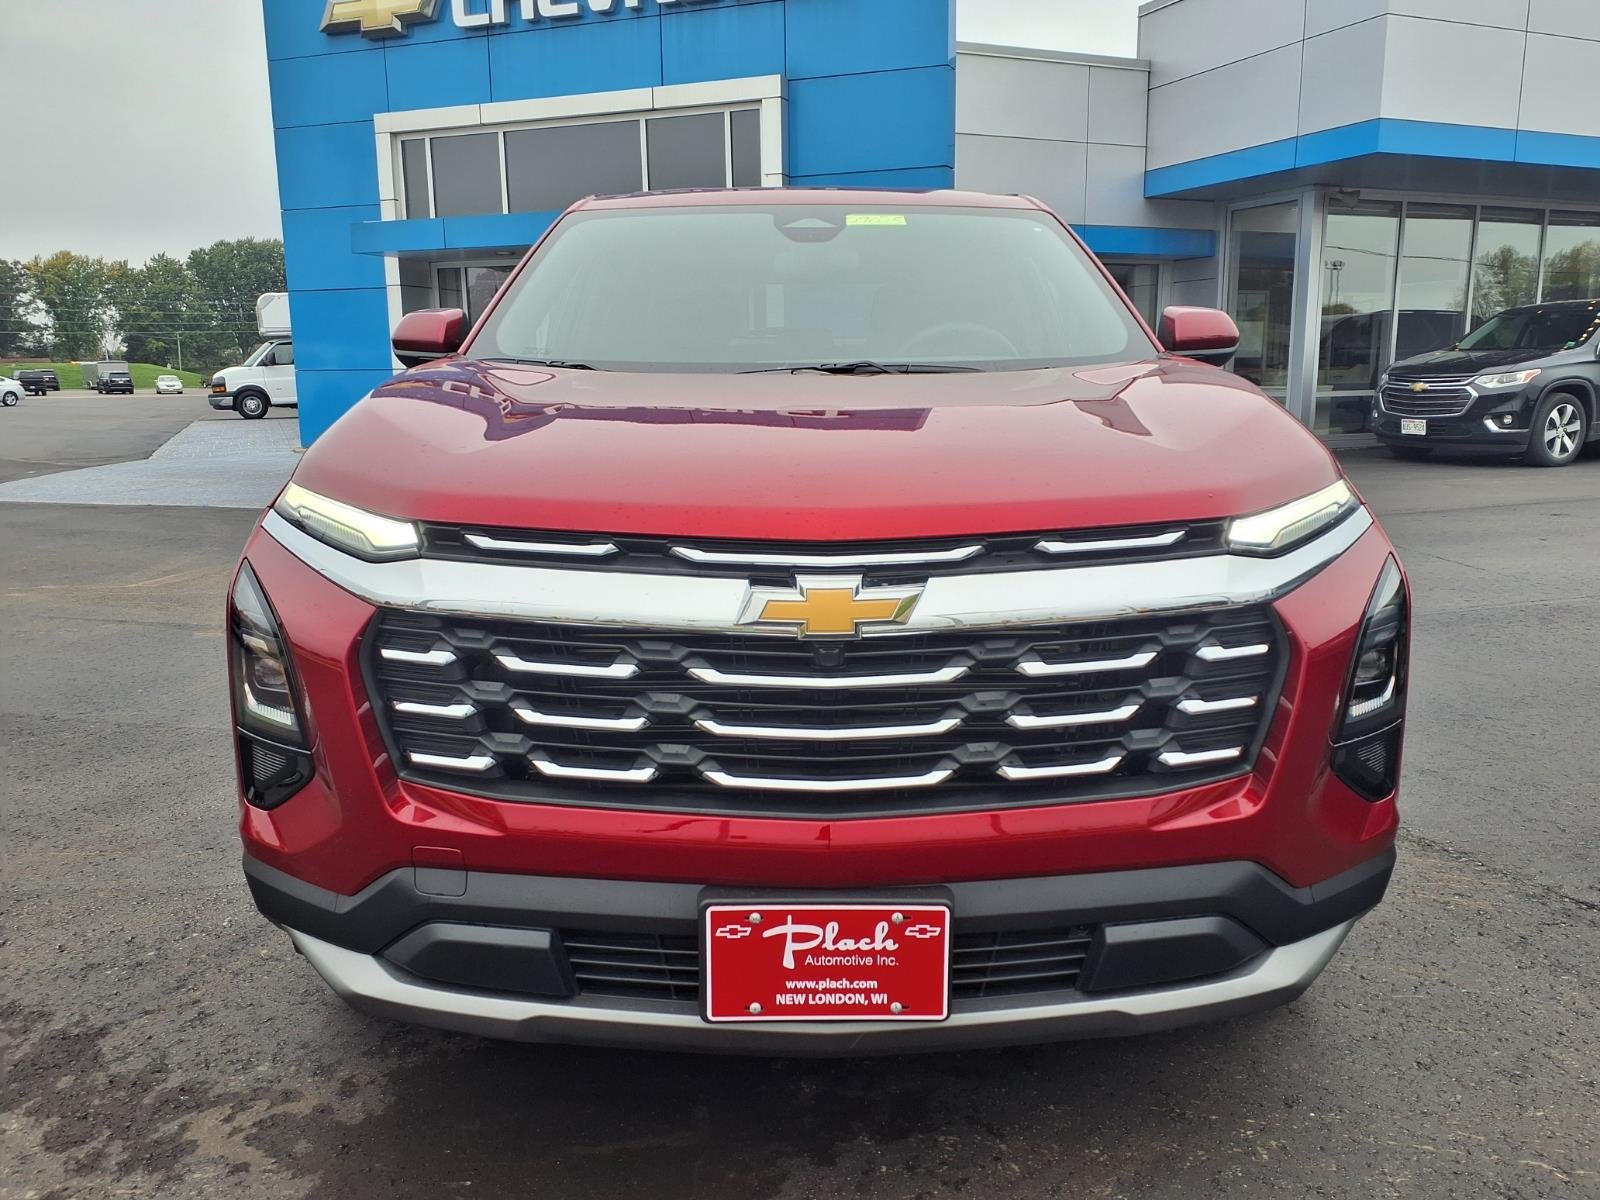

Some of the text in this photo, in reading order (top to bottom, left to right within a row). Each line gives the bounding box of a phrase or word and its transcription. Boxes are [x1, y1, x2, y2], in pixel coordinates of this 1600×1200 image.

[762, 914, 899, 970] Plach
[804, 954, 899, 966] Automotive Inc.
[785, 978, 878, 991] www.plach.com
[775, 993, 888, 1006] NEW LONDON, WI
